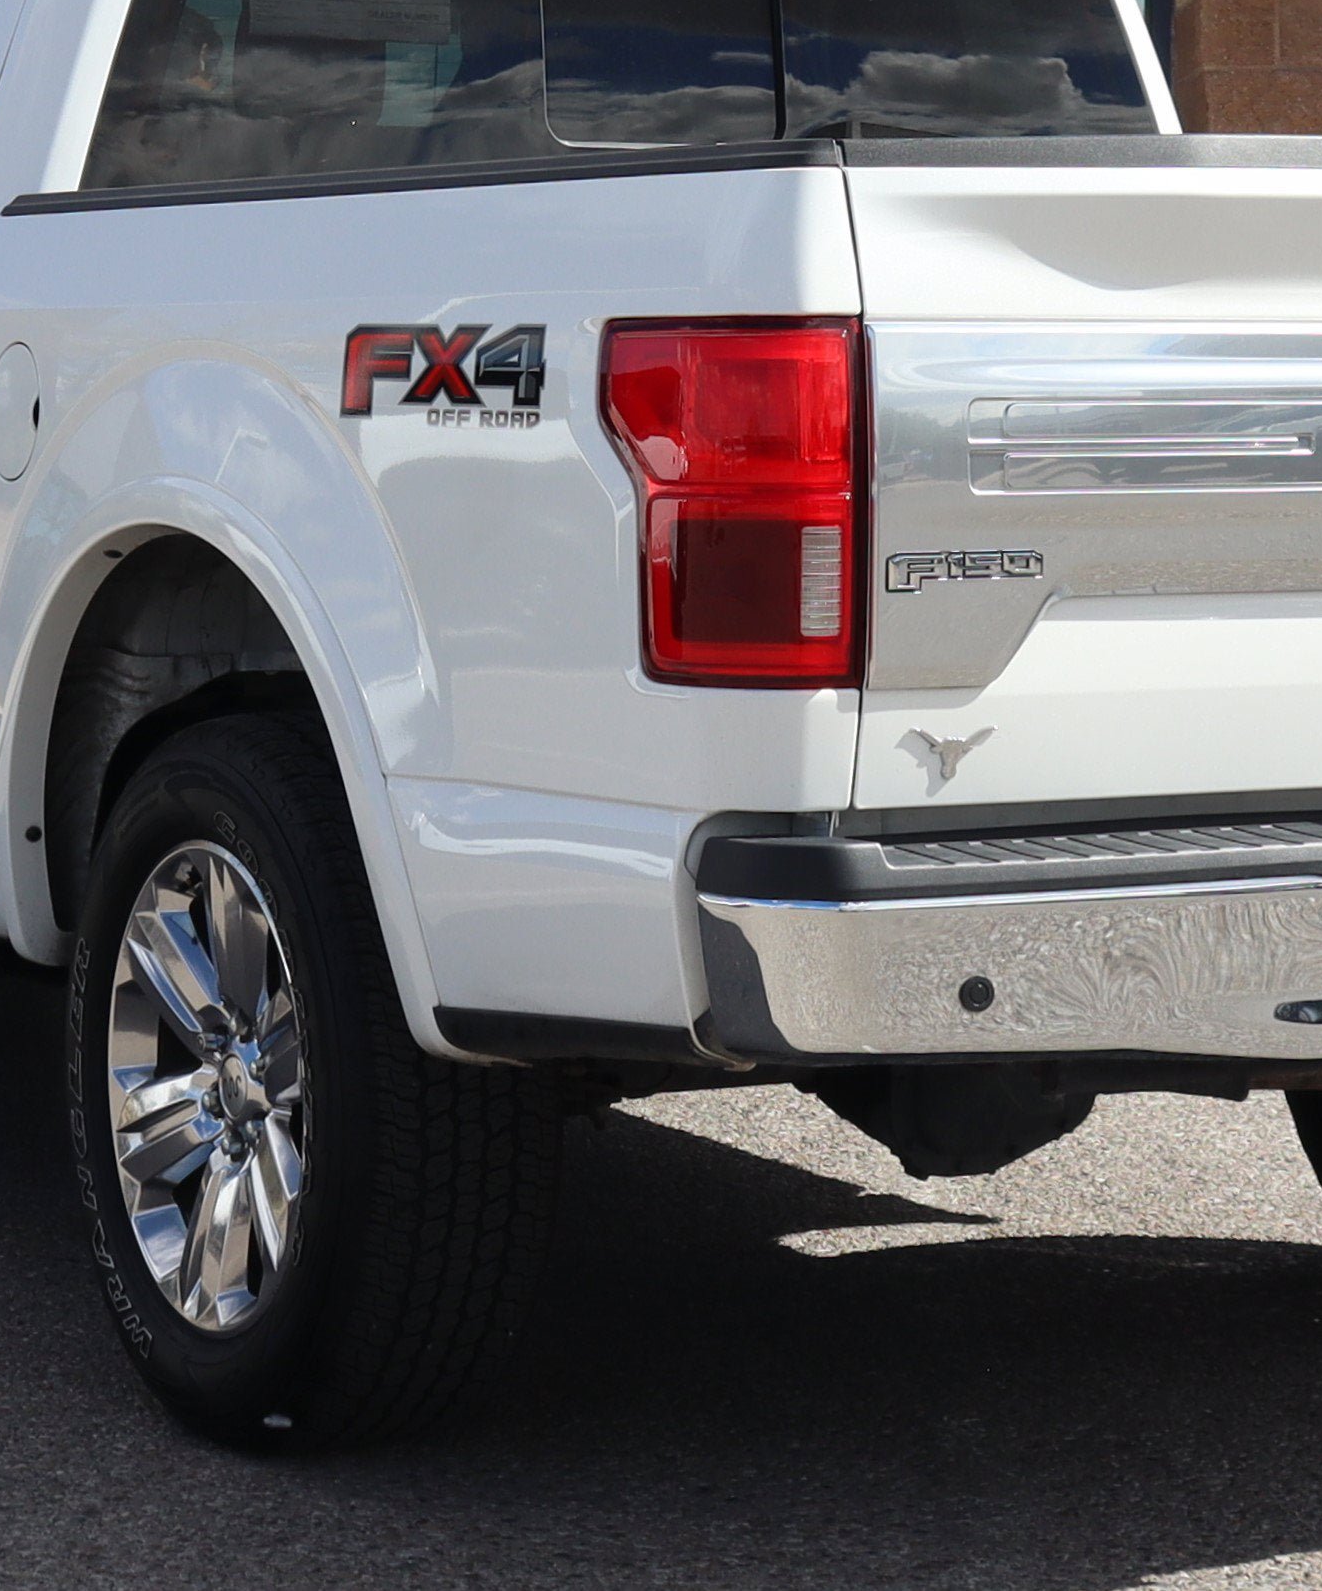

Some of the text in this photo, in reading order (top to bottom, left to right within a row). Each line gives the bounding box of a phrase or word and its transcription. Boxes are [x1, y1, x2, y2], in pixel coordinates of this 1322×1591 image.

[340, 322, 546, 417] FX4
[426, 408, 541, 429] OFF ROAD
[68, 937, 154, 1360] WRANGLER
